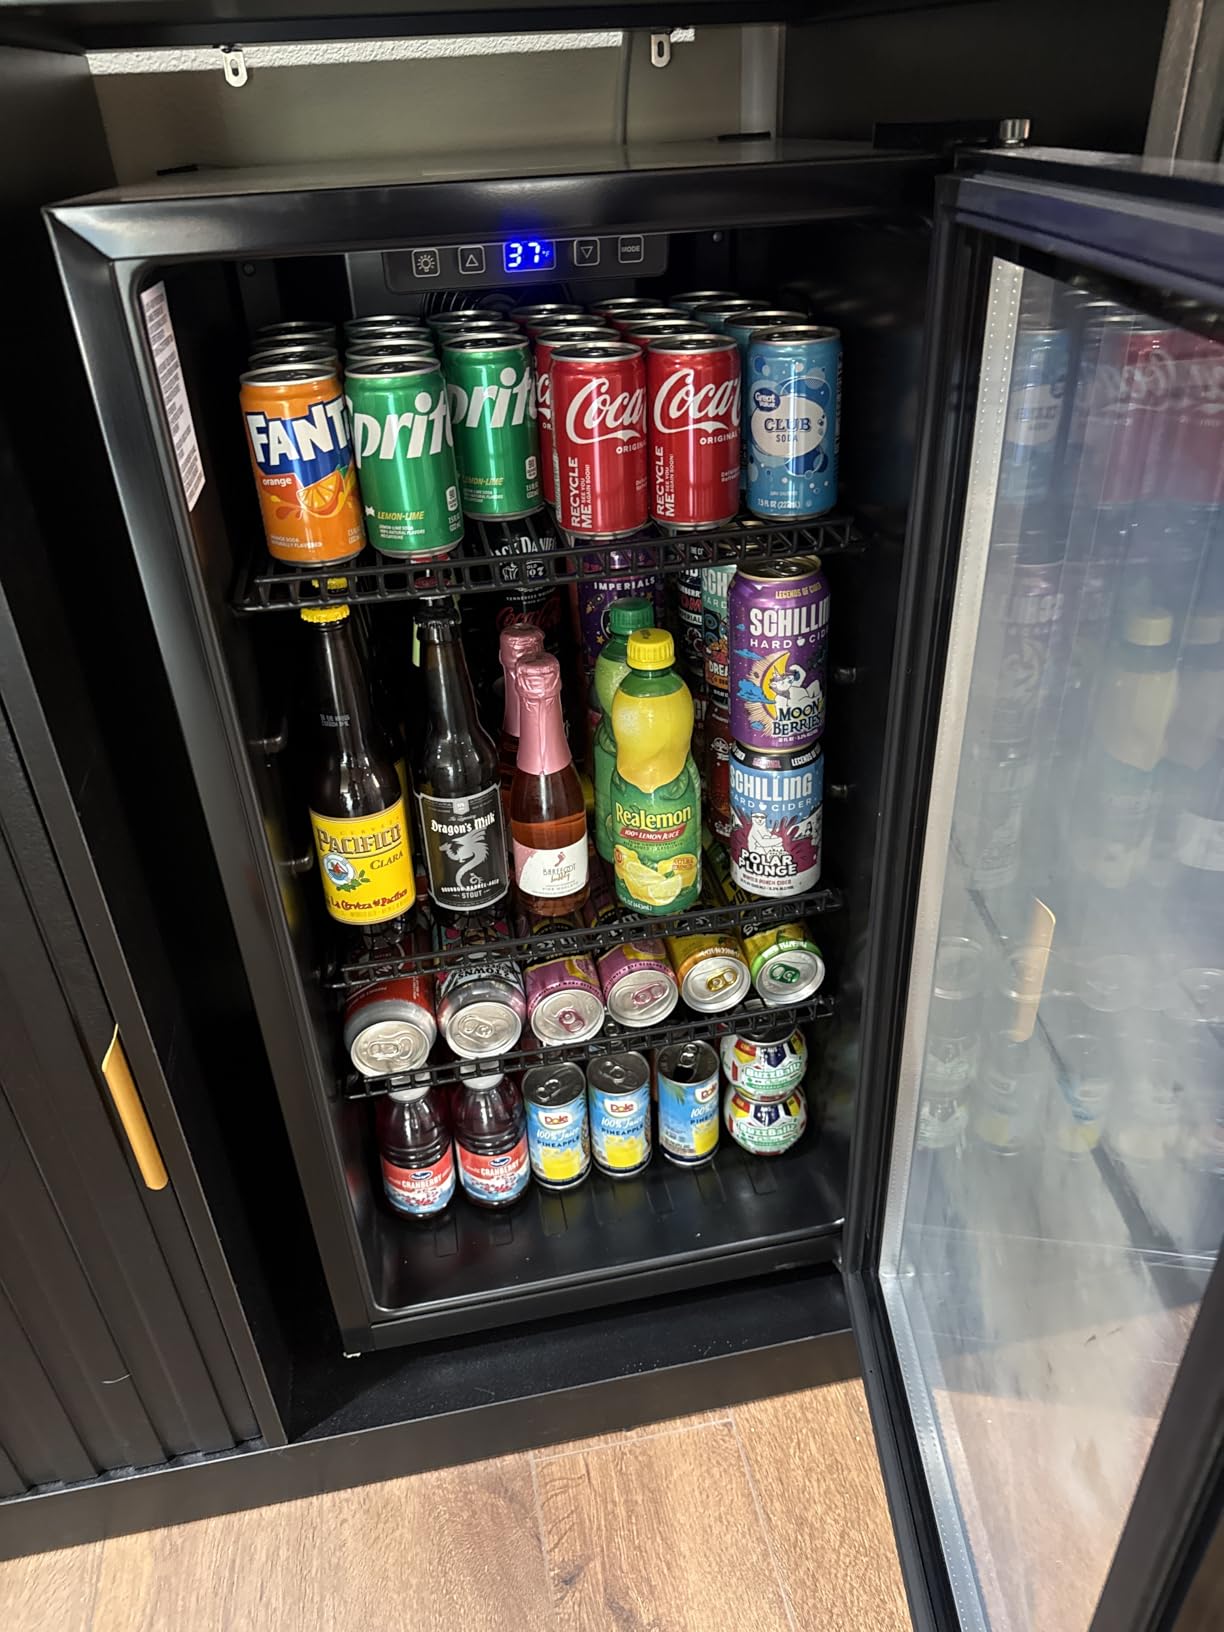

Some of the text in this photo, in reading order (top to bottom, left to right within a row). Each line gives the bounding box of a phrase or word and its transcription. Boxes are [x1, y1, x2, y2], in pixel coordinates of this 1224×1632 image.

[621, 246, 640, 254] MODE
[755, 392, 776, 403] Great
[345, 390, 453, 469] prit
[764, 418, 812, 433] CLUB
[776, 434, 799, 443] SODA
[261, 478, 293, 488] orange
[655, 446, 665, 515] RECYCLE
[568, 456, 581, 527] RECYCLE
[665, 494, 675, 517] ME
[377, 511, 425, 521] LEMON-LIME
[580, 504, 592, 528] ME
[594, 576, 656, 591] IMPERIALS
[750, 639, 792, 649] HARD
[778, 699, 820, 722] MOON
[772, 714, 822, 736] BERRIES
[791, 753, 812, 767] LEGENDS
[730, 765, 813, 801] SCHILLING
[732, 794, 813, 812] ARD CIDER
[431, 819, 472, 836] Dragon's
[474, 811, 495, 830] Milk
[615, 801, 692, 832] ReaLemon
[317, 824, 401, 854] PACIFICO
[638, 831, 661, 840] LEMON
[661, 829, 681, 841] JUICE
[370, 851, 404, 870] CLARA
[741, 848, 793, 866] POLAR
[738, 857, 797, 877] PLUNGE
[461, 890, 482, 899] STOUT
[341, 900, 372, 911] Cerveza
[458, 967, 502, 978] TOWNS
[745, 1062, 802, 1078] BuzzBallz
[610, 1103, 634, 1113] Dole
[544, 1116, 569, 1125] Dole
[601, 1117, 623, 1128] 100%
[537, 1129, 559, 1141] 100%
[602, 1125, 643, 1136] PINEAPPLE
[739, 1123, 797, 1136] BuzzBallz
[537, 1136, 580, 1148] PINEAPPLE
[480, 1161, 519, 1176] CRANBERRY
[402, 1173, 442, 1188] CRANBERRY
